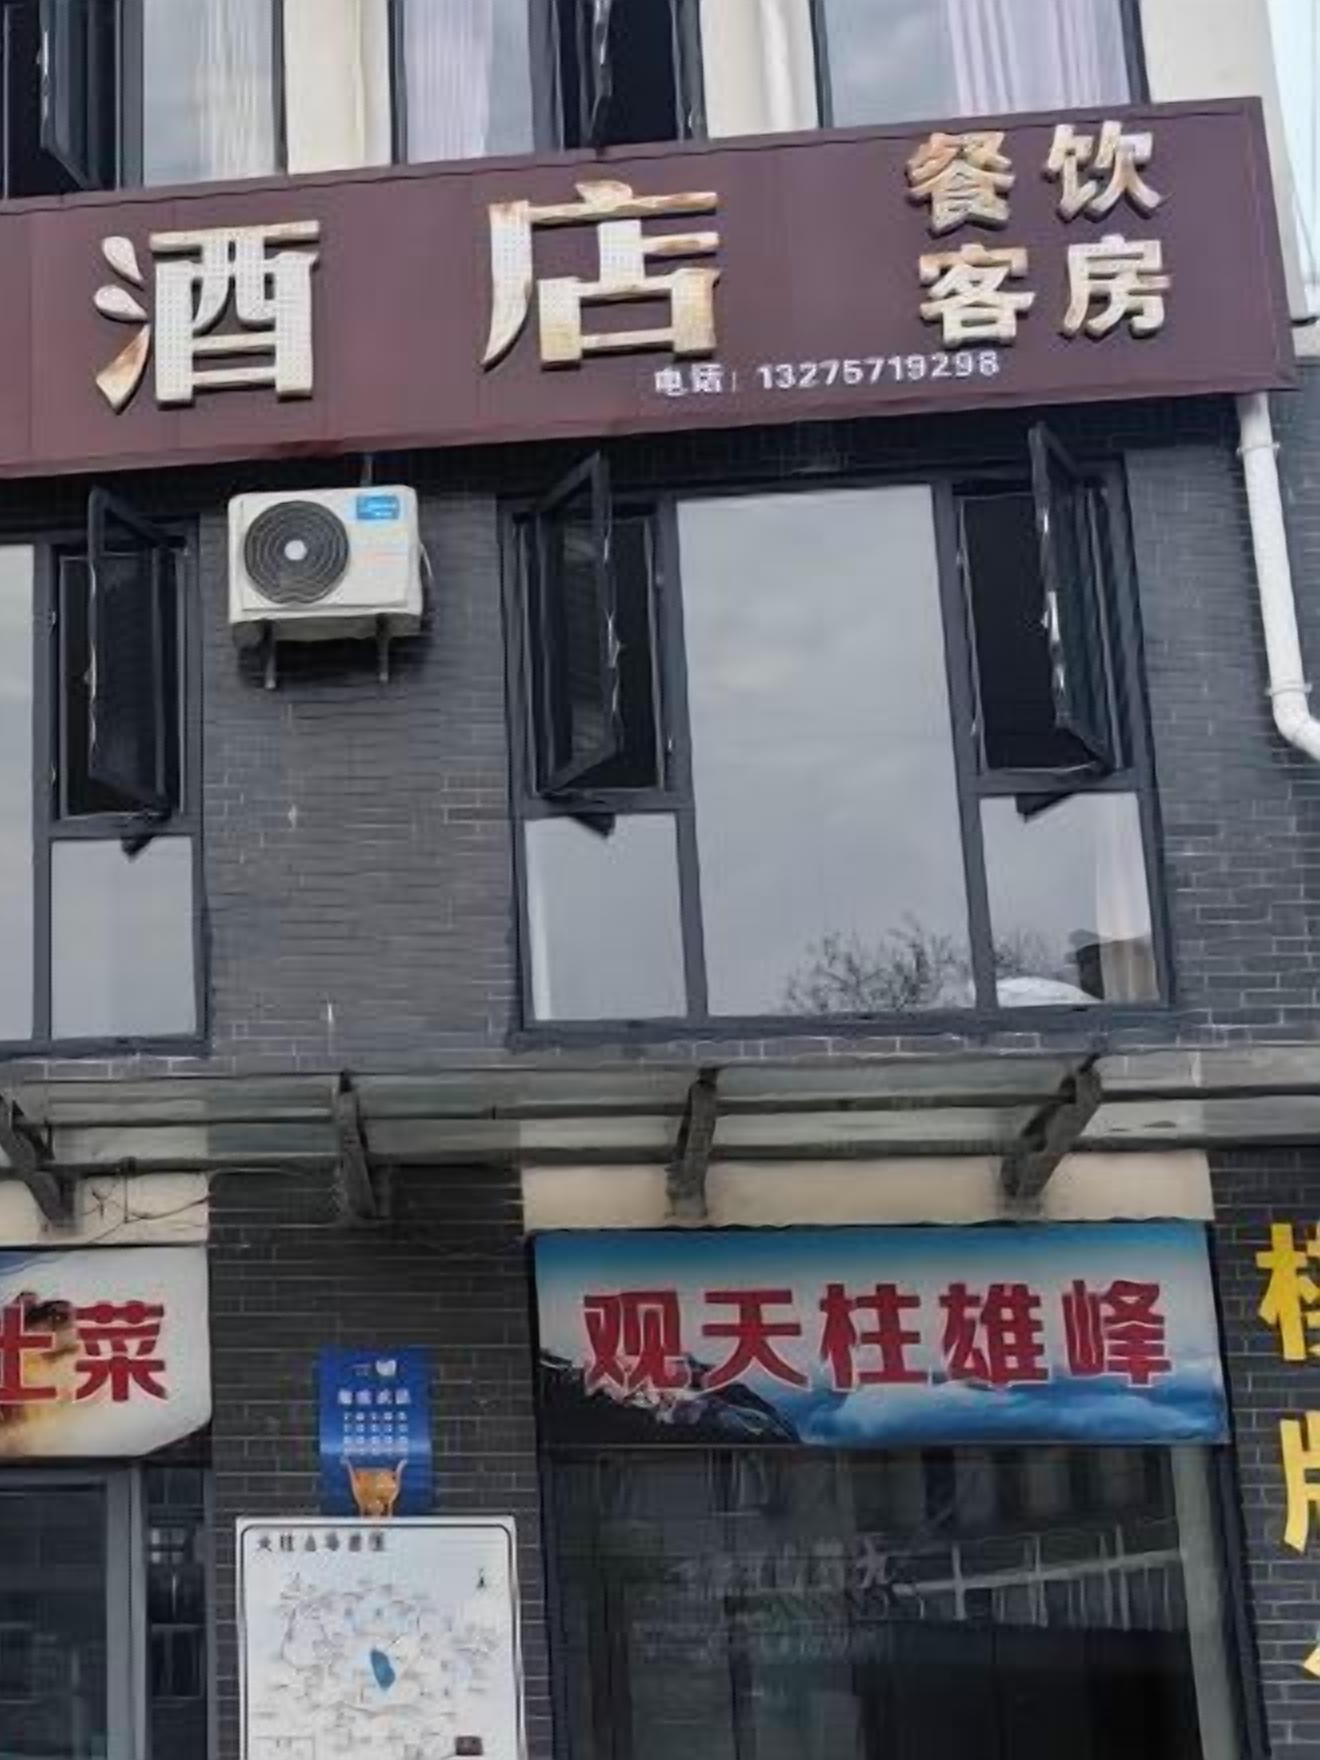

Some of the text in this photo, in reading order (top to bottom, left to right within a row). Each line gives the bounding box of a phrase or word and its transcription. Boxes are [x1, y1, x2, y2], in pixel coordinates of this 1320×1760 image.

[906, 118, 1163, 236] 餐饮
[916, 232, 1172, 350] 客房
[582, 1279, 1173, 1392] 观天柱雄峰
